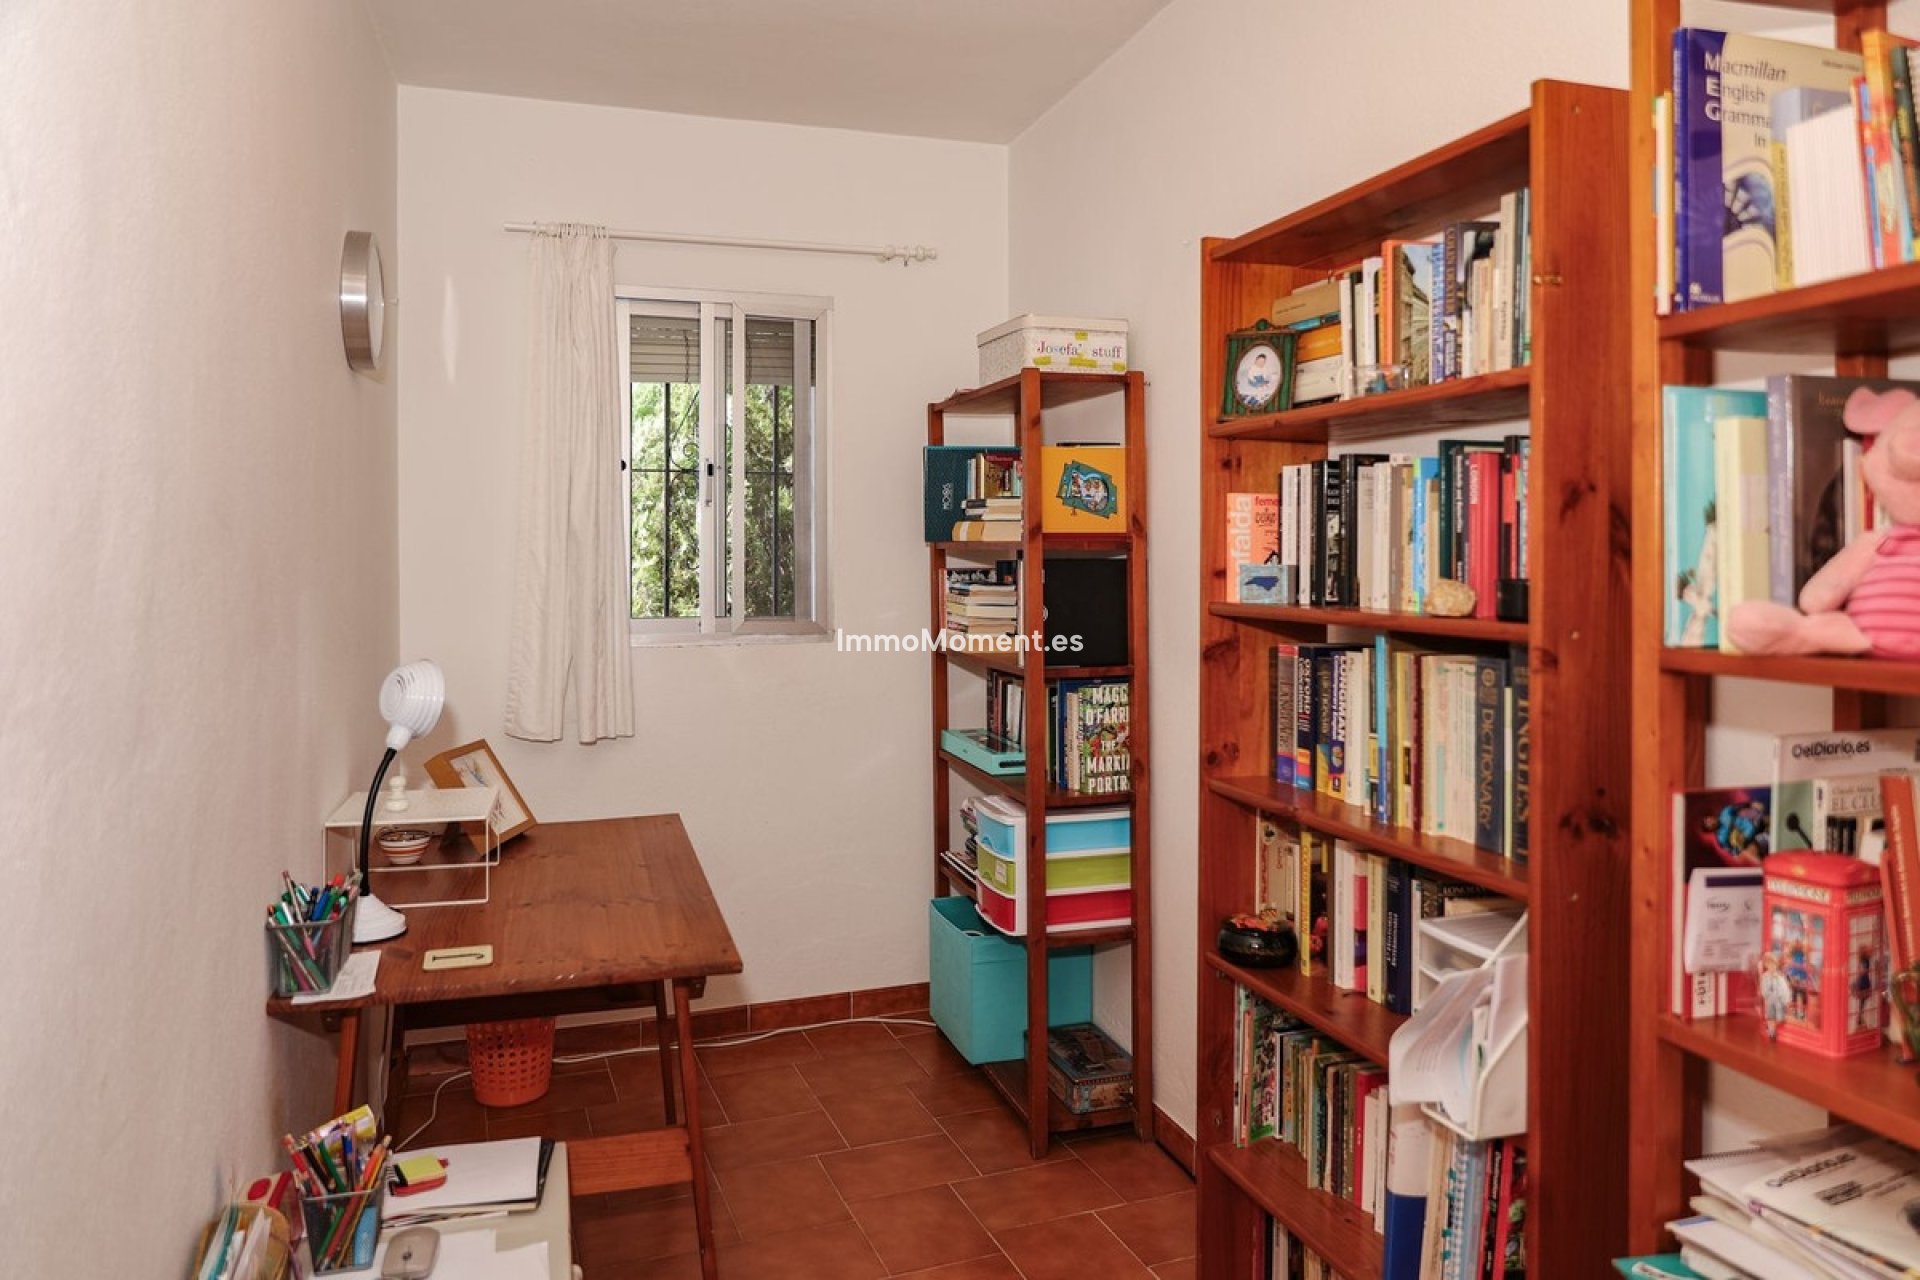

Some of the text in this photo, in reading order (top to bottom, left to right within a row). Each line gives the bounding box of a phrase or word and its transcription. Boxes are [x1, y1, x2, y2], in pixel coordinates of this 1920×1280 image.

[1704, 52, 1786, 82] Macmillan
[1706, 76, 1766, 104] English
[1092, 346, 1122, 358] stuff
[1303, 659, 1312, 714] OXFORD
[1338, 655, 1347, 741] LONGMAN
[1479, 708, 1495, 830] DICTIONARY
